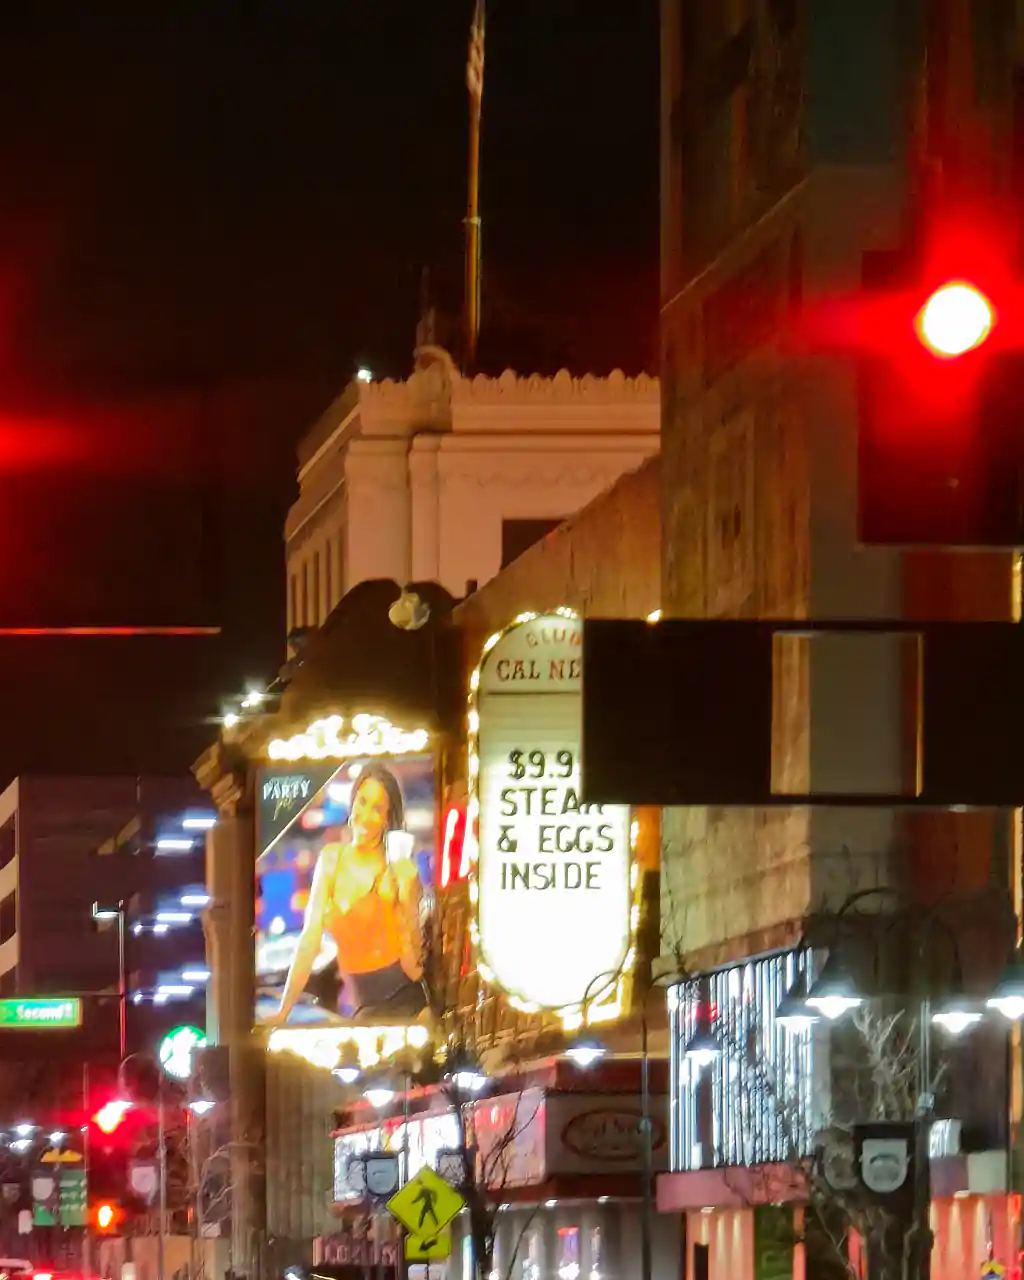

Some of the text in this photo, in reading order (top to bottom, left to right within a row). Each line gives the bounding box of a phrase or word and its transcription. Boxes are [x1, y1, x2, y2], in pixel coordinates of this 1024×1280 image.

[496, 659, 581, 680] CAL NE
[507, 748, 575, 780] $9.9
[263, 779, 311, 799] PARTY
[497, 824, 615, 853] & EGGS
[501, 862, 602, 890] INSIDE
